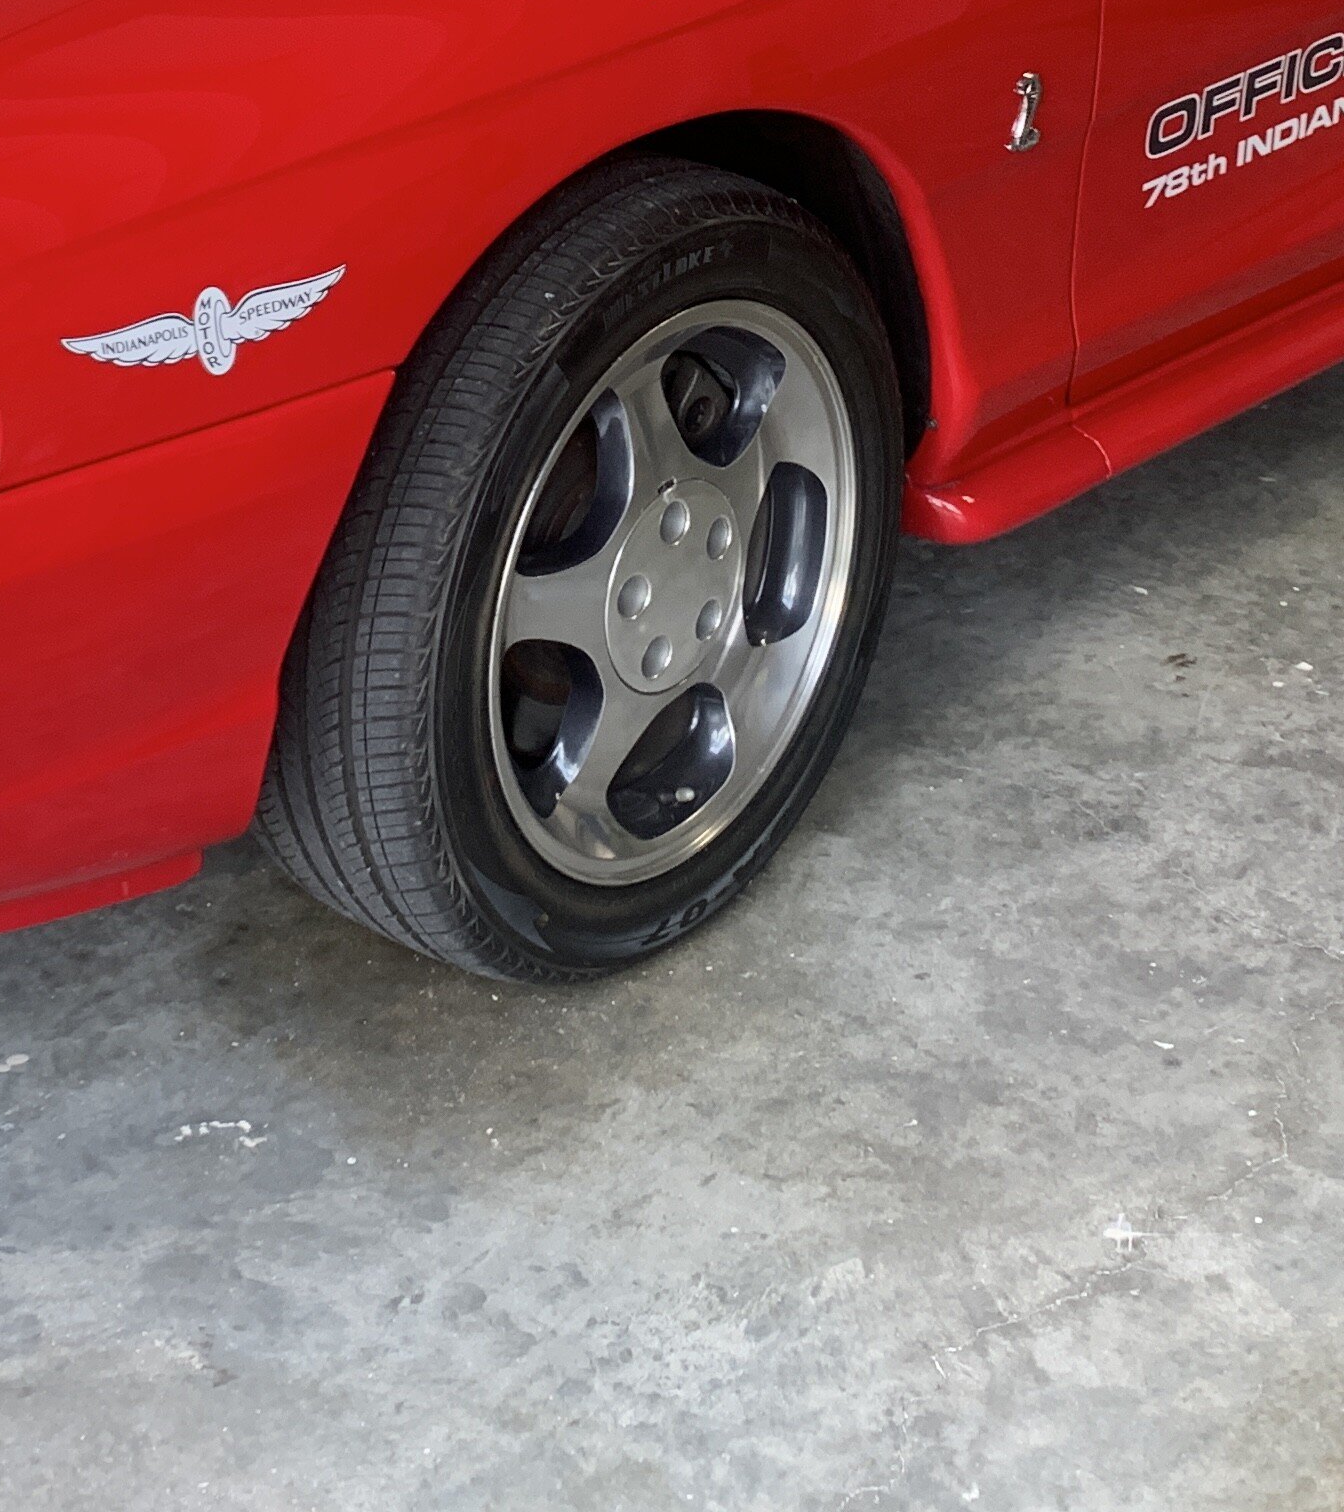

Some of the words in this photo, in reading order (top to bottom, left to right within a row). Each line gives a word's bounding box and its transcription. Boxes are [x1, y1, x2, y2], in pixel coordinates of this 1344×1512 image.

[1142, 153, 1227, 208] 78th
[101, 326, 189, 355] INDIANAPOLIS
[197, 297, 221, 369] MOTOR
[239, 289, 312, 324] SPEEDWAY
